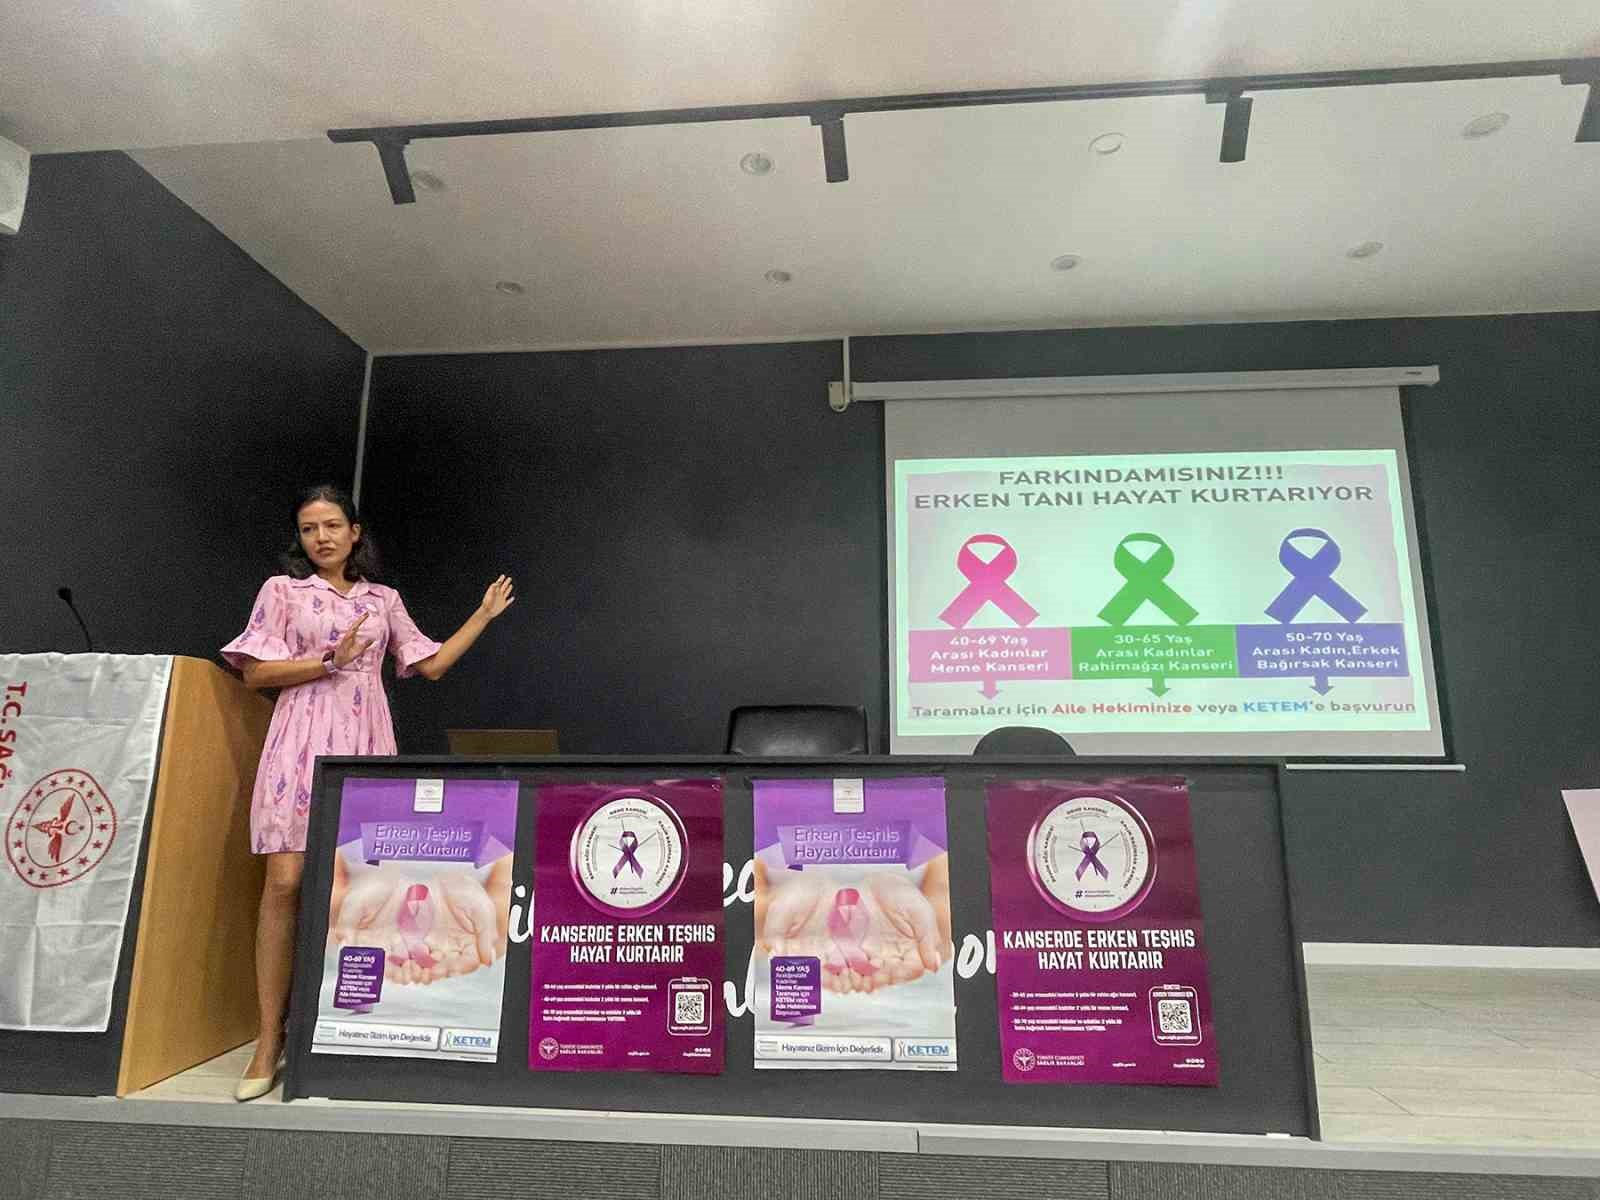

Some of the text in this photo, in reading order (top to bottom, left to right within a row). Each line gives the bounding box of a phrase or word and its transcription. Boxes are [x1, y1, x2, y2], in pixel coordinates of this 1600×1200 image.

[999, 465, 1284, 486] FARKINDAMISINIZ!!!
[914, 486, 1374, 509] ERKEN TANI HAYAT KURTARIYOR
[950, 634, 1028, 647] 40-69 Yaş
[1114, 633, 1193, 646] 30-65 Yaş
[1285, 631, 1364, 644] 50-70 Yaş
[930, 648, 1049, 661] Arası Kadınlar
[1095, 647, 1215, 658] Arası Kadınlar
[1252, 646, 1295, 656] Arası
[930, 661, 1049, 673] Meme Kanseri
[1168, 660, 1233, 671] Kanseri
[1257, 658, 1399, 671] Bağırsak Kanseri
[912, 705, 1011, 717] Taramaları
[1016, 704, 1047, 718] için
[1052, 703, 1087, 714] Aile
[1092, 703, 1192, 714] Hekiminize
[1198, 703, 1238, 715] veya
[1330, 700, 1415, 714] başvurun
[375, 823, 420, 840] Erken
[793, 827, 842, 842] Erken
[373, 839, 415, 858] Hayat
[793, 845, 839, 861] Hayat
[540, 925, 614, 943] KANSERDE
[617, 924, 663, 942] ERKEN
[1003, 930, 1084, 949] KANSERDE
[1087, 929, 1138, 948] ERKEN
[570, 945, 685, 963] HAYAT KURTARIR
[1038, 951, 1164, 970] HAYAT KURTARIR
[452, 1035, 492, 1048] KETEM
[907, 1044, 949, 1057] KETEM
